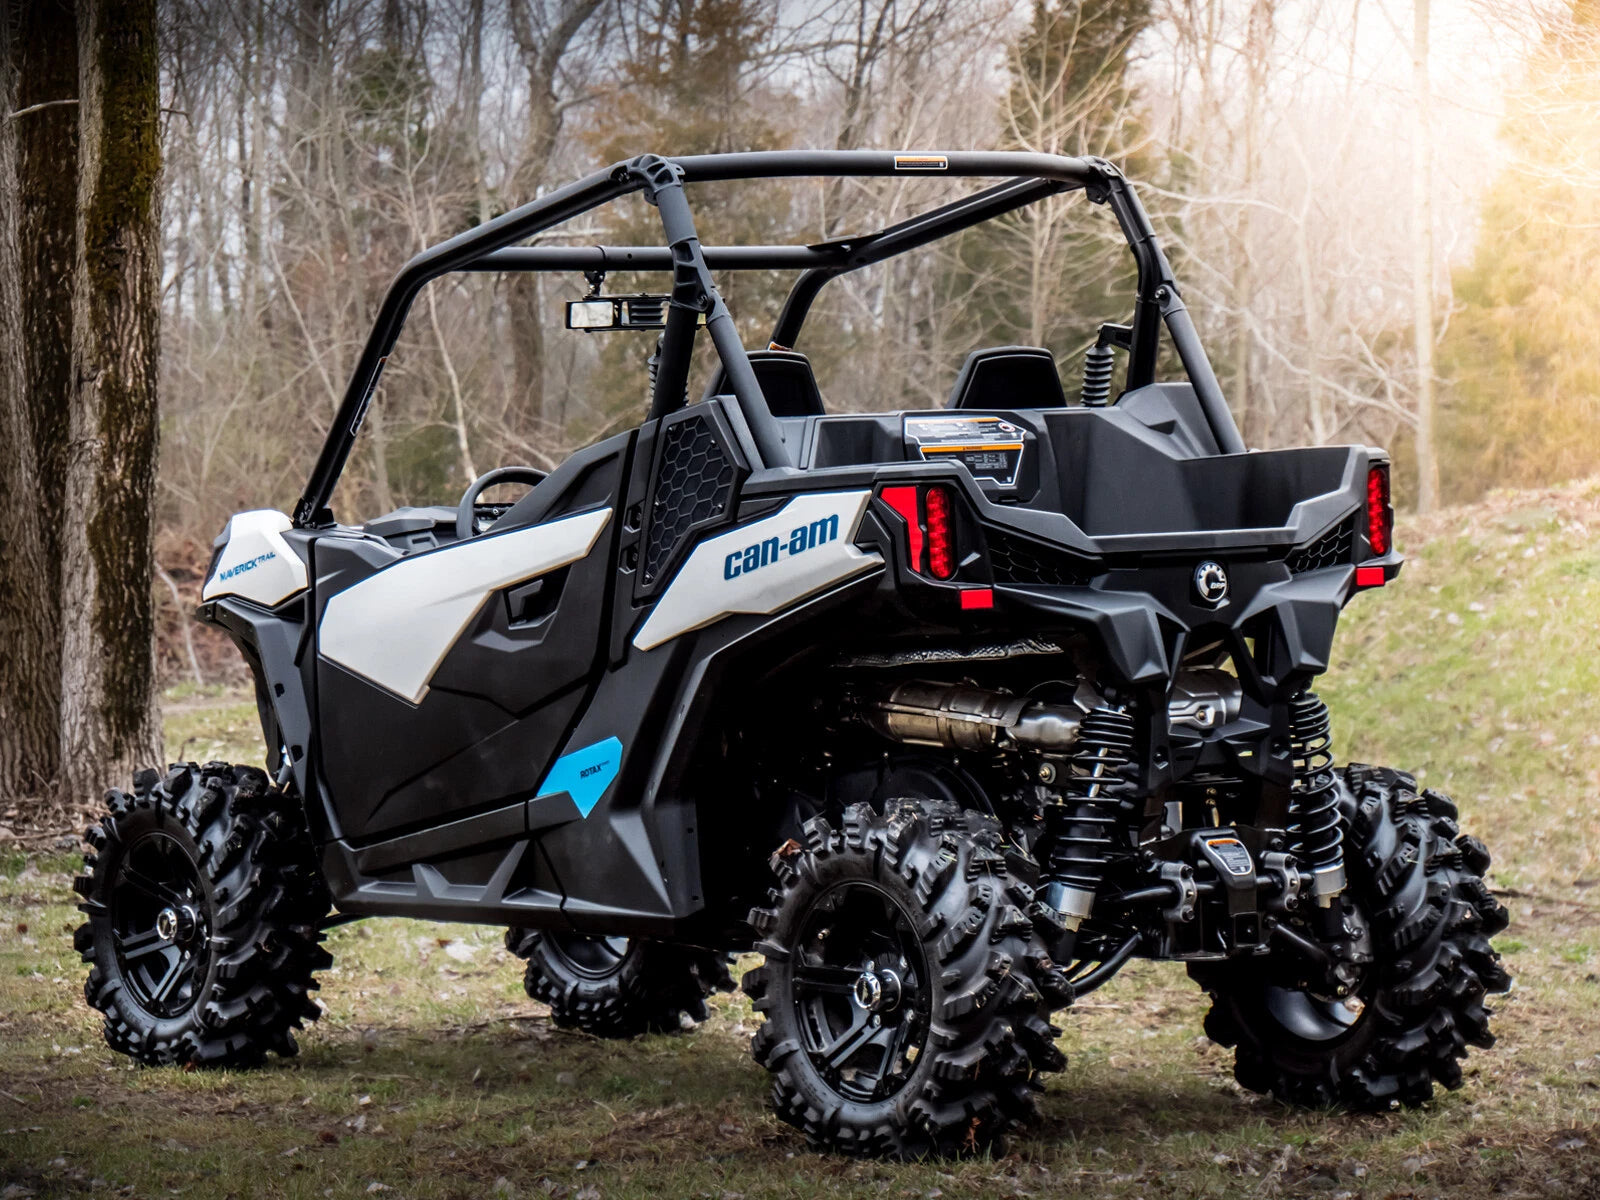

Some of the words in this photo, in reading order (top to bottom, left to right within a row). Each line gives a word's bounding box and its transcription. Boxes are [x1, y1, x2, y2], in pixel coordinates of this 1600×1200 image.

[724, 514, 839, 580] can-am
[220, 559, 258, 580] MAVERICK
[580, 764, 602, 779] ROTAX
